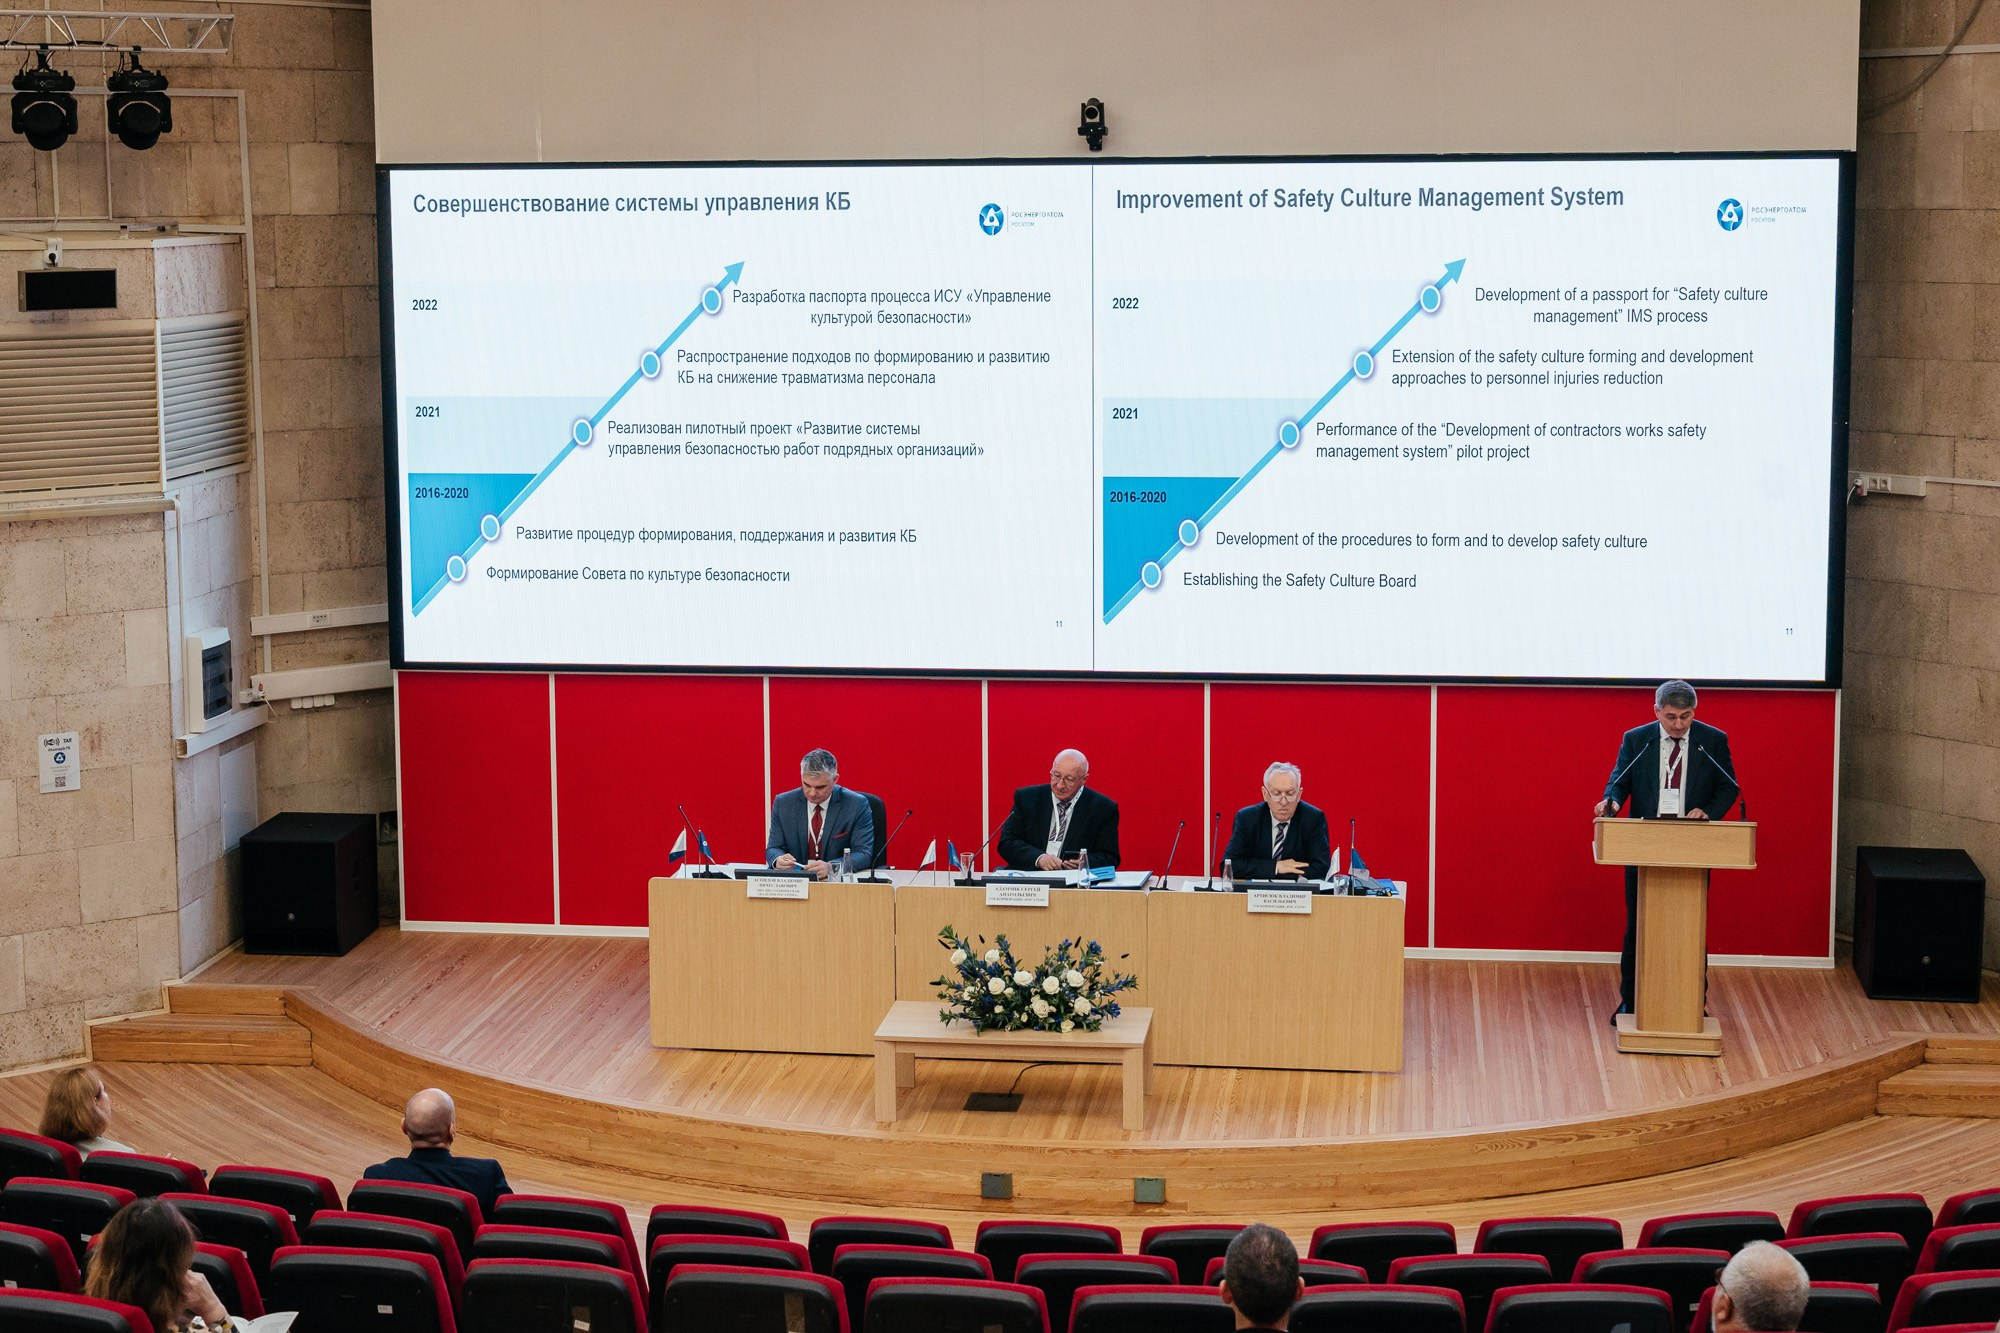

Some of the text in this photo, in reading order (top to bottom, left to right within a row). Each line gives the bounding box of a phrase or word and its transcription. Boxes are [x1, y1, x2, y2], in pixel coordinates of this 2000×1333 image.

[413, 191, 851, 218] Совершенствование системы управления КБ
[1116, 185, 1624, 214] Improvement of Safety Culture Management System
[412, 298, 438, 311] 2022
[732, 288, 1052, 307] Разработка паспорта процесса ИСУ «Управление
[1112, 297, 1140, 310] 2022
[1475, 286, 1769, 305] Development of a passport for “Safety culture
[810, 309, 972, 328] культурой безопасности»
[1533, 308, 1709, 327] management” IMS process
[677, 348, 1051, 367] Распространение подходов по формированию и развитию
[1392, 348, 1754, 367] Extension of the safety culture forming and development
[677, 369, 936, 388] КБ на снижение травматизма персонала
[1391, 370, 1663, 388] approaches to personnel injuries reduction
[415, 405, 440, 418] 2021
[1112, 407, 1138, 420] 2021
[607, 420, 921, 438] Реализован пилотный проект «Развитие системы
[1316, 421, 1707, 441] Performance of the “Development of contractors works safety
[607, 440, 985, 460] управления безопасностью работ подрядных организаций»
[1316, 443, 1531, 462] management system” pilot project
[414, 486, 470, 499] 2016-2020
[1109, 490, 1167, 504] 2016-2020
[516, 525, 918, 546] Развитие процедур формирования, поддержания и развития КБ
[1216, 531, 1648, 552] Development of the procedures to form and to develop safety culture
[486, 565, 791, 584] Формирование Совета по культуре безопасности
[1183, 571, 1417, 591] Establishing the Safety Culture Board
[1055, 620, 1063, 628] 11
[1785, 627, 1793, 636] 11
